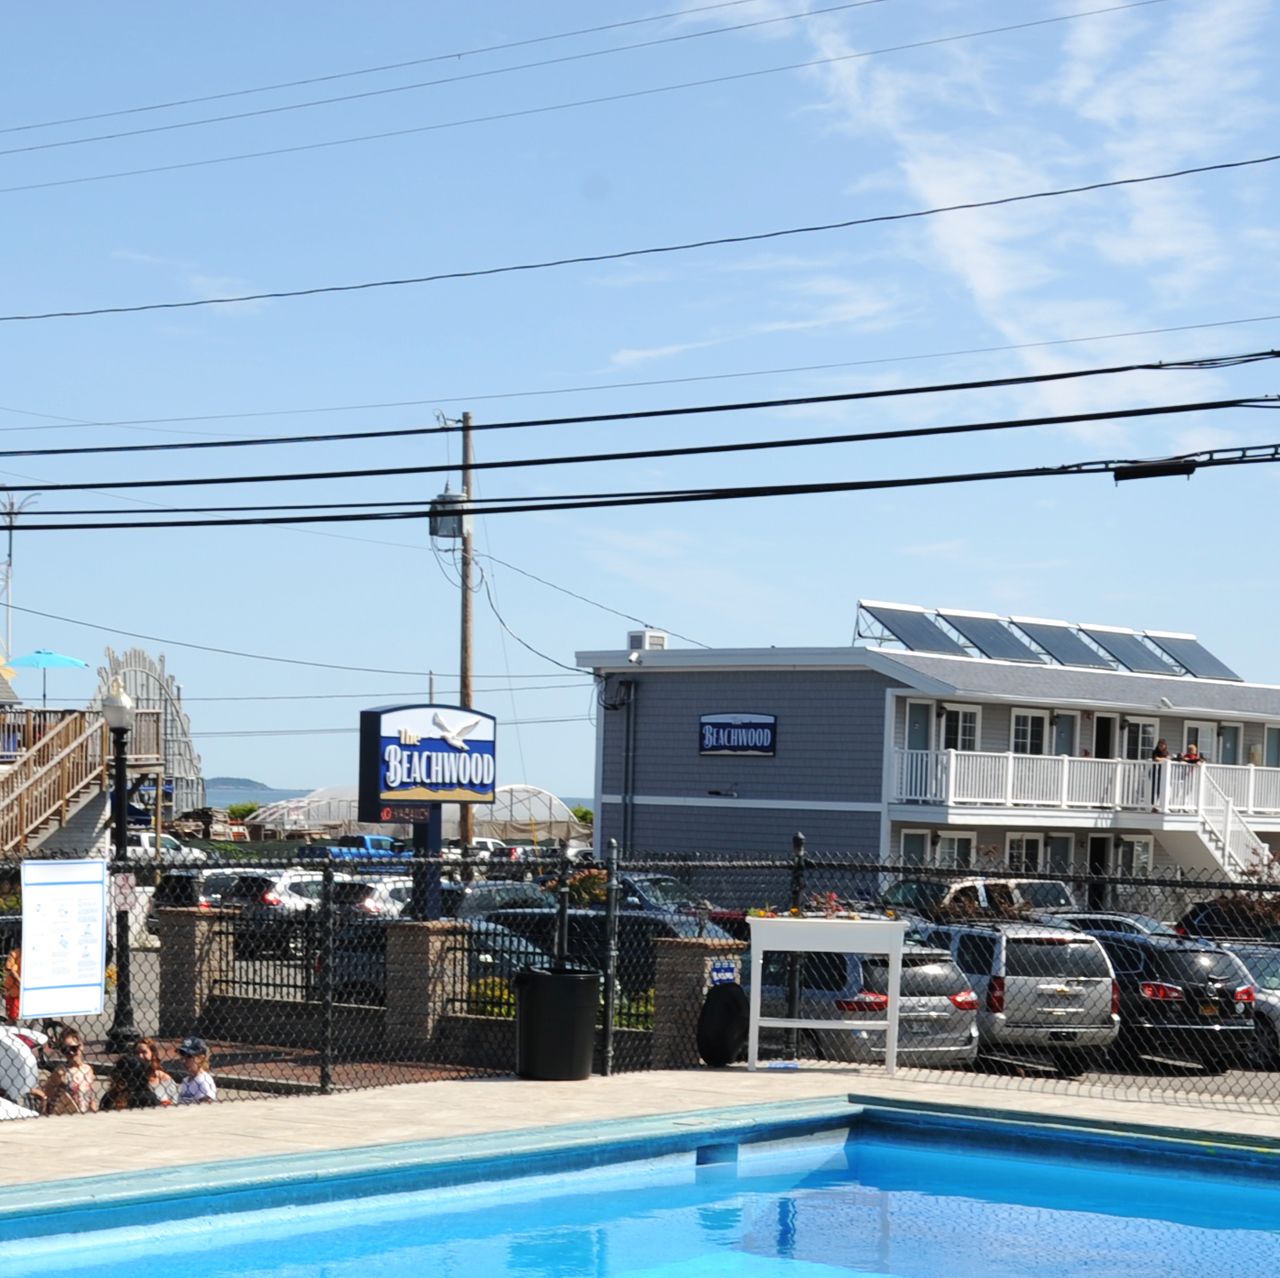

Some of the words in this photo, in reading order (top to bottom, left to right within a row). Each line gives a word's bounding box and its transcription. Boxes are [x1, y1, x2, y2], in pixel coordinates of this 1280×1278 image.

[397, 728, 422, 746] The
[702, 725, 772, 749] BEACHWOOD
[384, 745, 494, 787] BEACHWOOD
